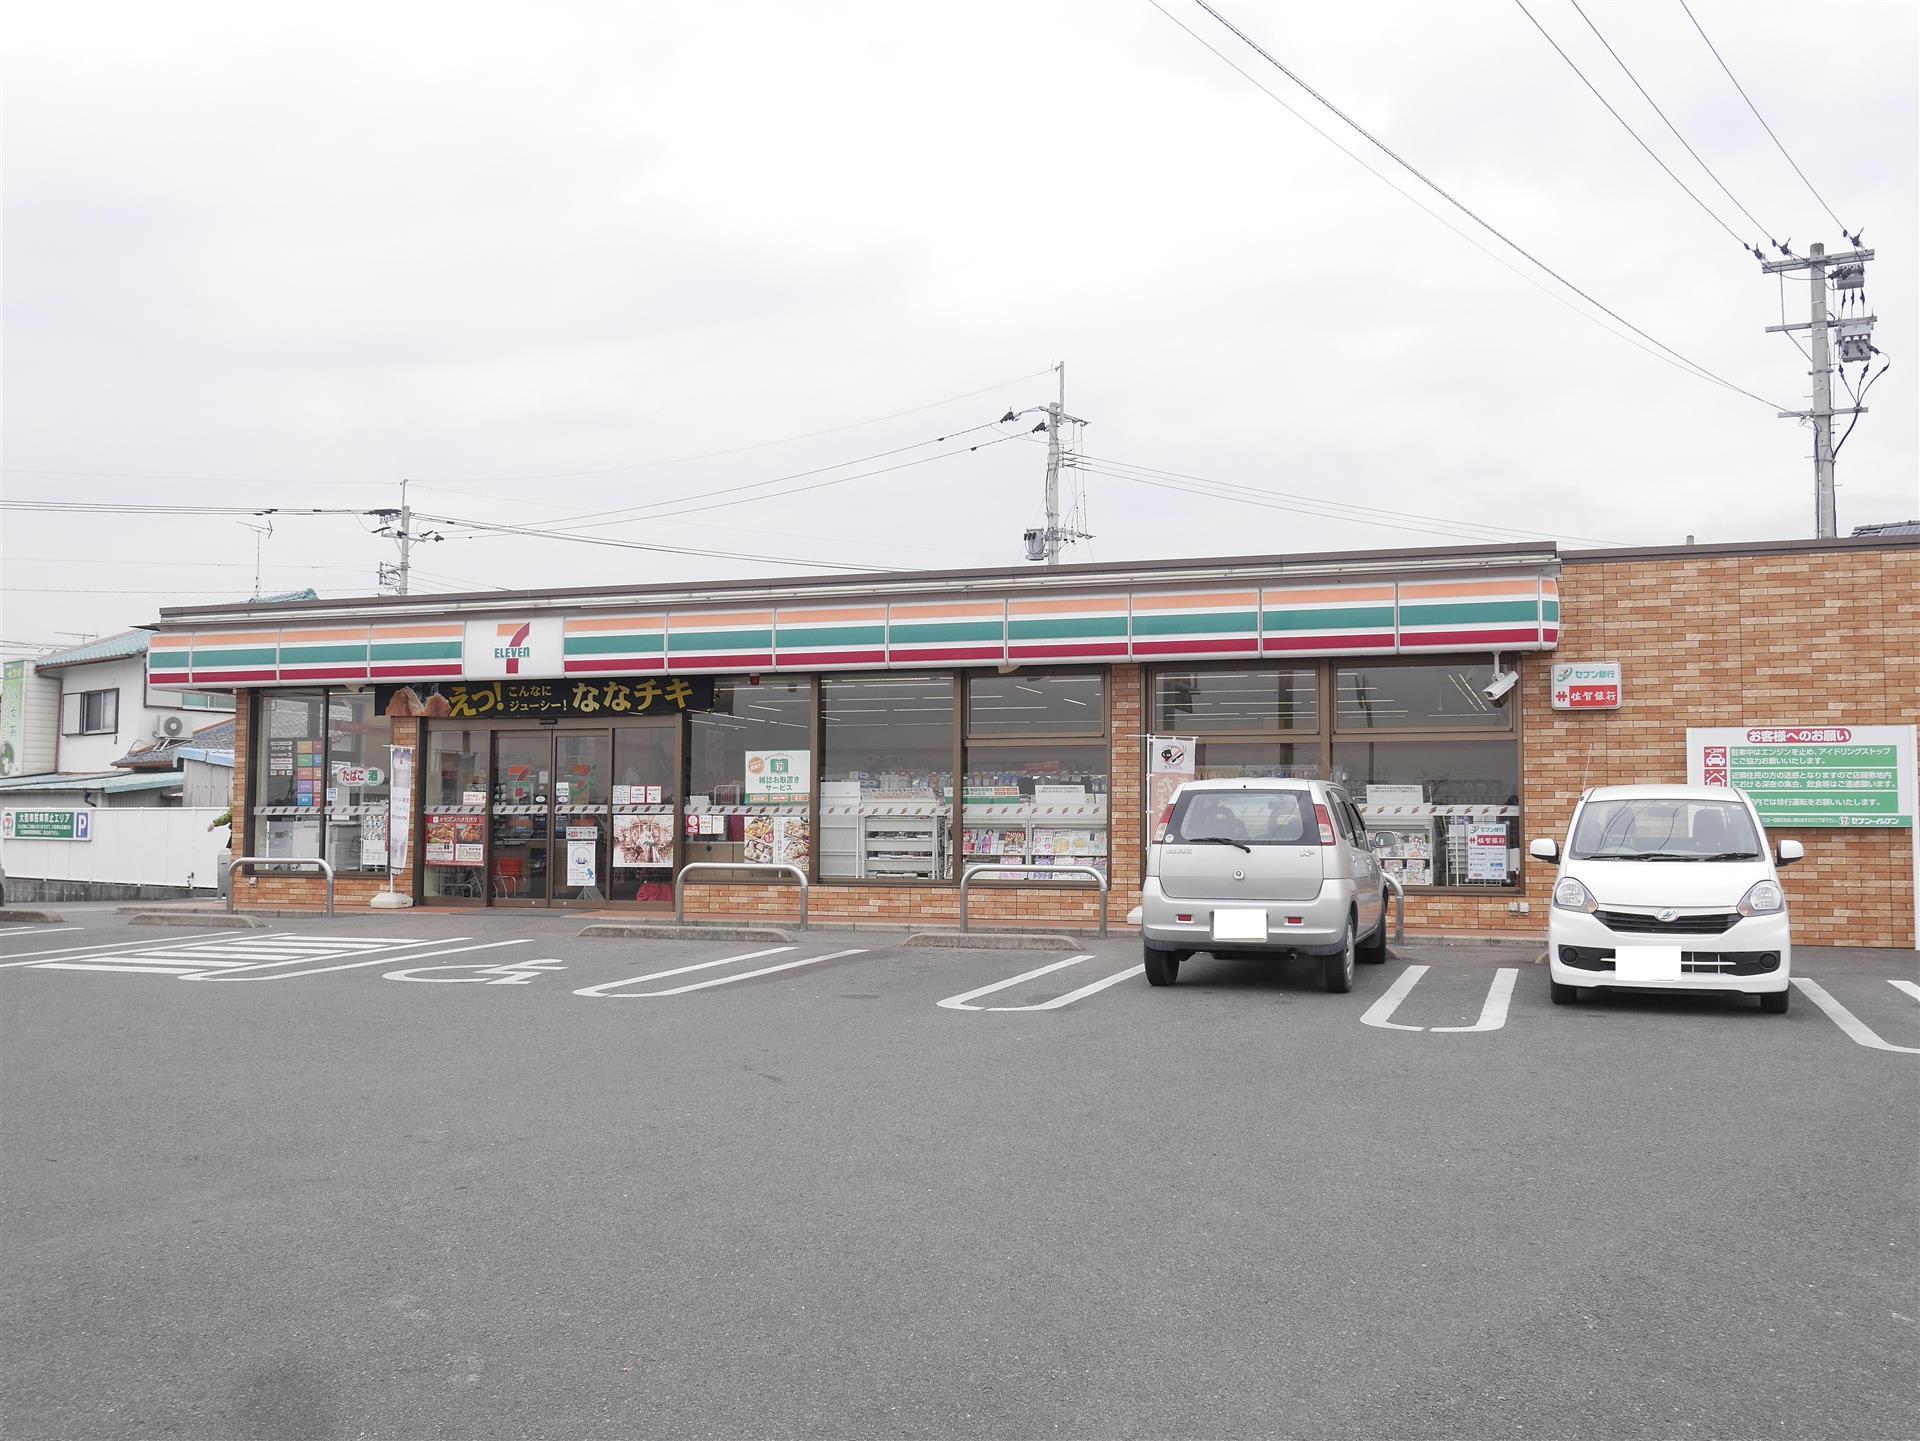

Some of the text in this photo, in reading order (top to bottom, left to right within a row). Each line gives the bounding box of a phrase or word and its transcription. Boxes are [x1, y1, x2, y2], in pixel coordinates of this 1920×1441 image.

[1575, 670, 1615, 679] セブン銀行
[509, 685, 552, 698] こんなに
[572, 678, 693, 712] ななチキ
[1570, 691, 1617, 702] 佐賀銀行
[450, 681, 504, 716] えっ!
[509, 699, 568, 712] ジューシー!
[1749, 730, 1850, 743] お客様へのお願い
[342, 770, 365, 782] たばこ
[368, 769, 378, 782] 酒
[766, 784, 793, 792] サービス
[78, 814, 87, 837] P
